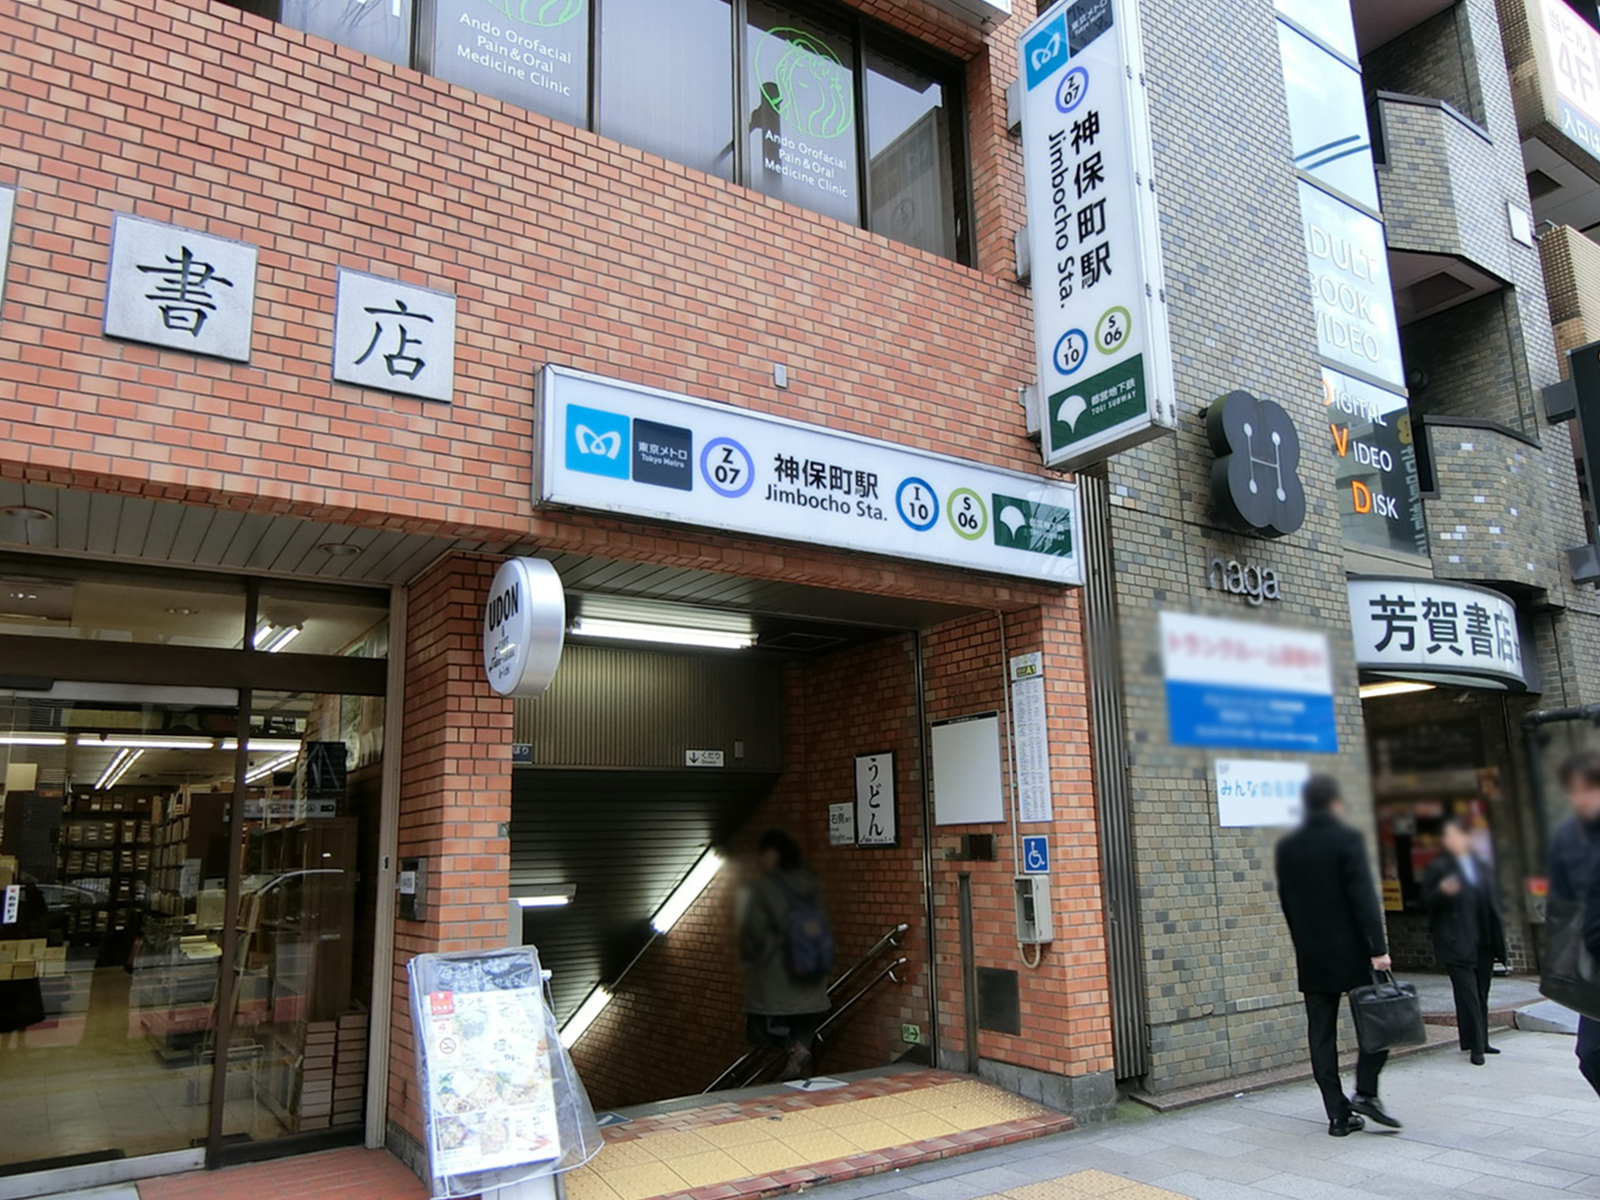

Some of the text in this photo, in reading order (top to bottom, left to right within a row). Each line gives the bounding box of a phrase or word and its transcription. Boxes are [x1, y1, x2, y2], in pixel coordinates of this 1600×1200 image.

[459, 13, 571, 64] Ando Orofacial
[457, 44, 571, 97] Medicine Clinic
[1067, 75, 1075, 89] Z
[1558, 42, 1593, 101] 4F
[1064, 84, 1080, 105] 07
[764, 129, 847, 170] Ando Orofacial
[764, 157, 848, 198] Medicine Clinic
[1048, 129, 1076, 309] Jimbocho Sta.
[1070, 110, 1113, 290] 神保町駅
[1306, 223, 1375, 284] DULT
[1104, 328, 1122, 346] 06
[1108, 314, 1116, 329] S
[1063, 349, 1080, 366] 10
[1108, 390, 1137, 409] SUBWAY
[638, 441, 688, 460] 東京メトロ
[641, 453, 685, 469] Tokyo Metro
[721, 447, 734, 465] Z
[714, 465, 741, 485] 07
[774, 453, 879, 500] 神保町駅
[765, 483, 888, 521] Jimbocho Sta.
[909, 502, 929, 520] 10
[963, 496, 972, 511] S
[1352, 479, 1400, 520] DISK
[958, 512, 978, 530] 06
[1208, 558, 1281, 606] naga
[489, 582, 519, 632] UDON
[868, 757, 884, 836] うどん
